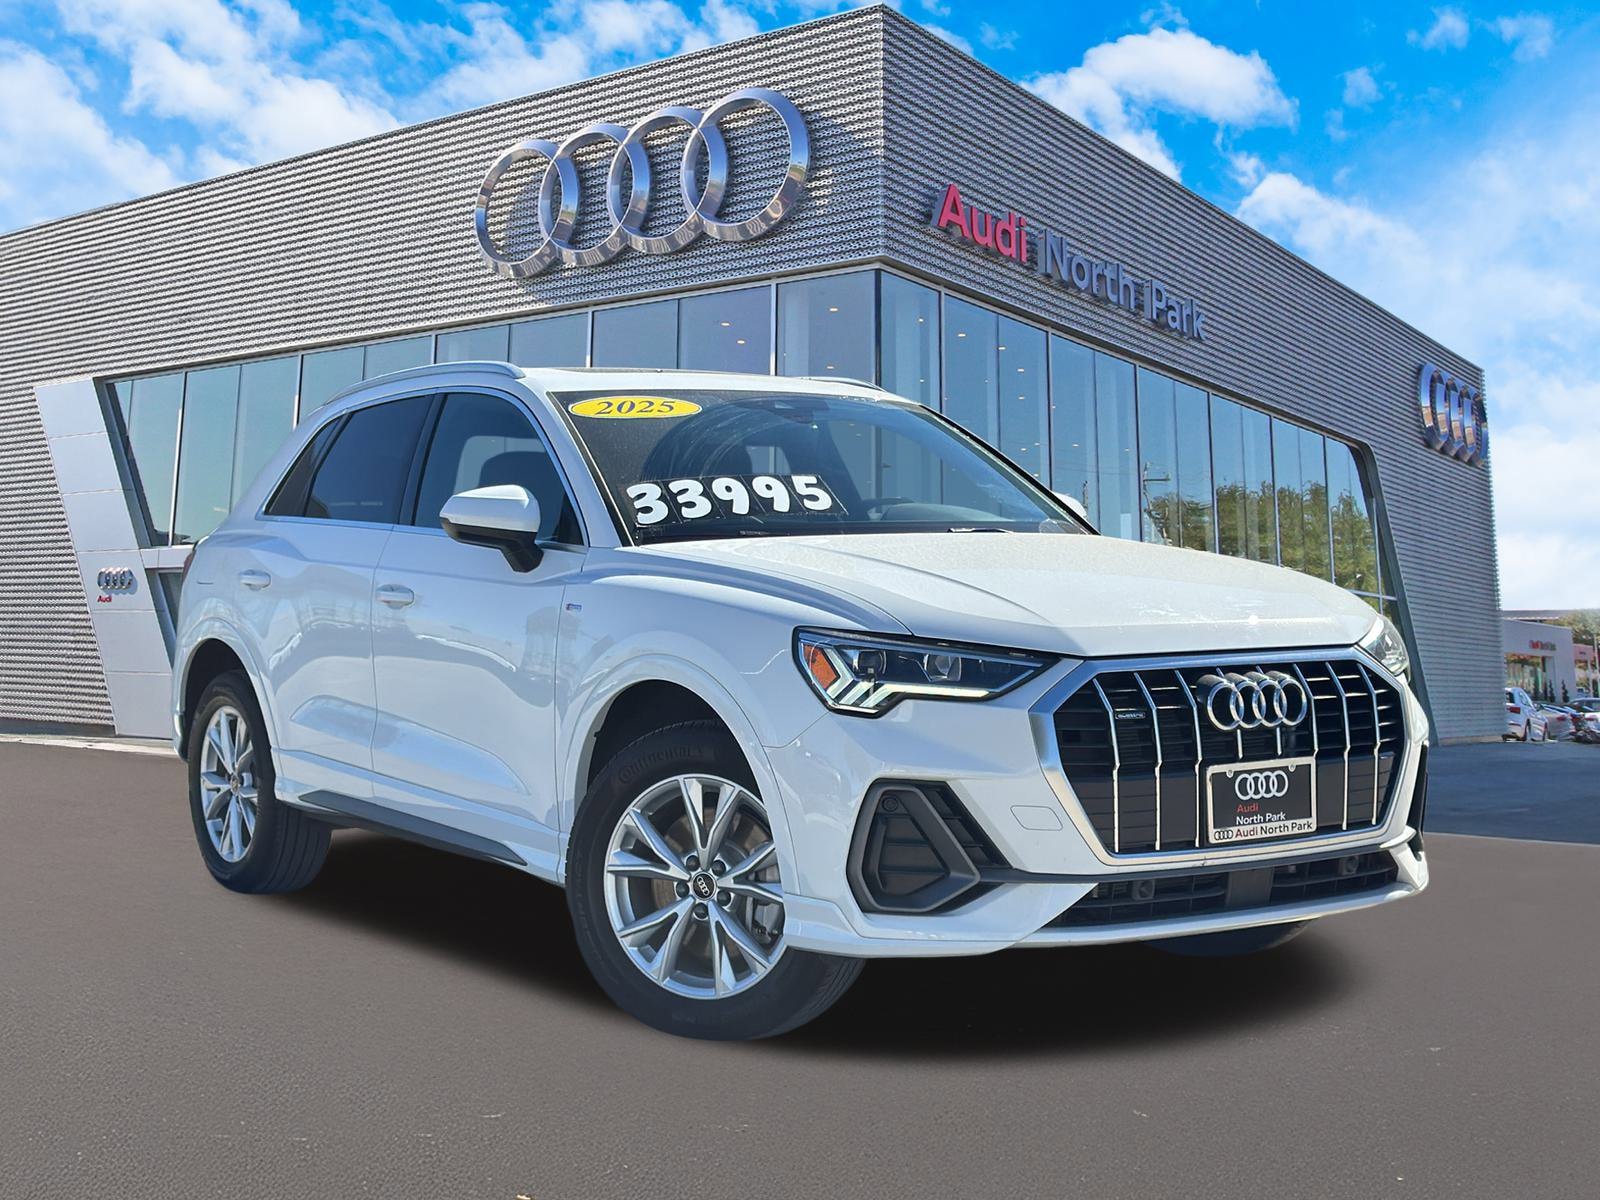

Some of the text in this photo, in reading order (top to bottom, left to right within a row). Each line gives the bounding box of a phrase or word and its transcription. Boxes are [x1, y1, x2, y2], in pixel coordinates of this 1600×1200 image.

[937, 183, 1208, 341] Audi North Park
[596, 400, 675, 415] 2025
[626, 475, 833, 525] 33995
[1236, 803, 1260, 813] Audi
[1236, 811, 1286, 825] North Park
[1235, 821, 1313, 838] Audi North Park
